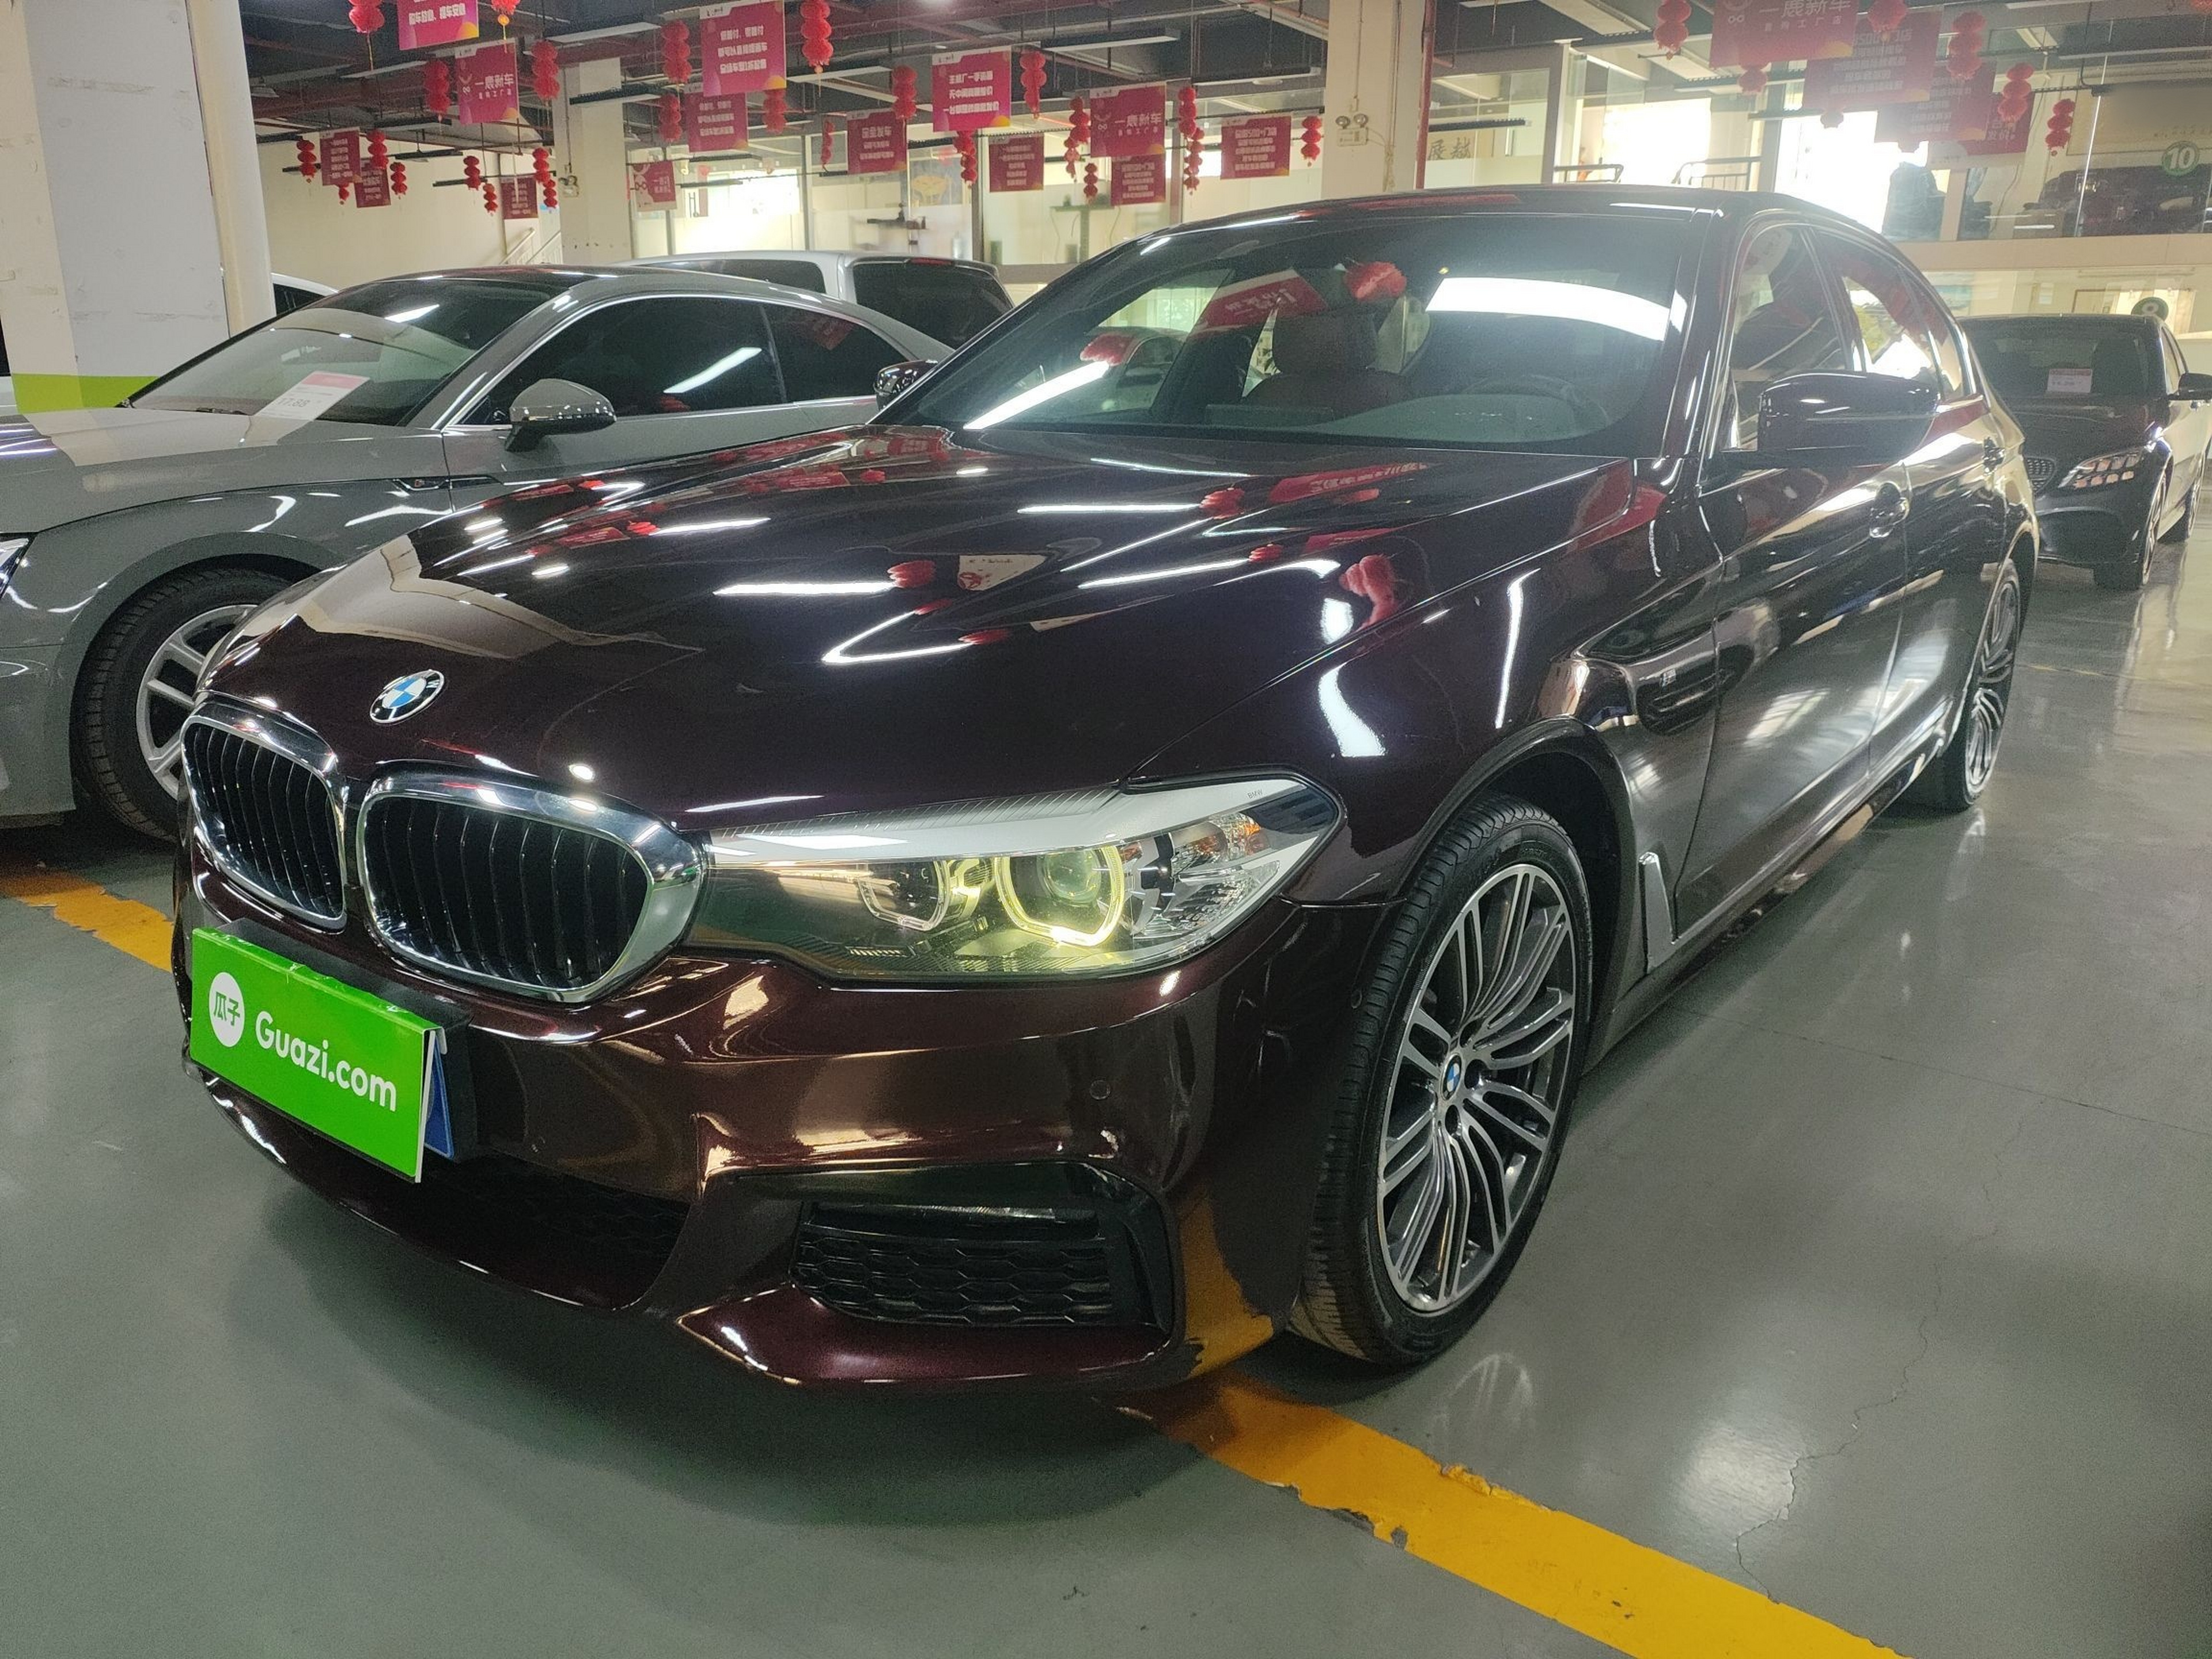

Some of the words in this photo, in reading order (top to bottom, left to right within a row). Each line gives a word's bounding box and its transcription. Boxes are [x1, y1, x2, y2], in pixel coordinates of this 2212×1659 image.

[2167, 143, 2195, 169] 10
[1247, 789, 1263, 799] BMW
[213, 991, 241, 1027] 瓜子
[255, 1010, 397, 1112] Guazi.com
